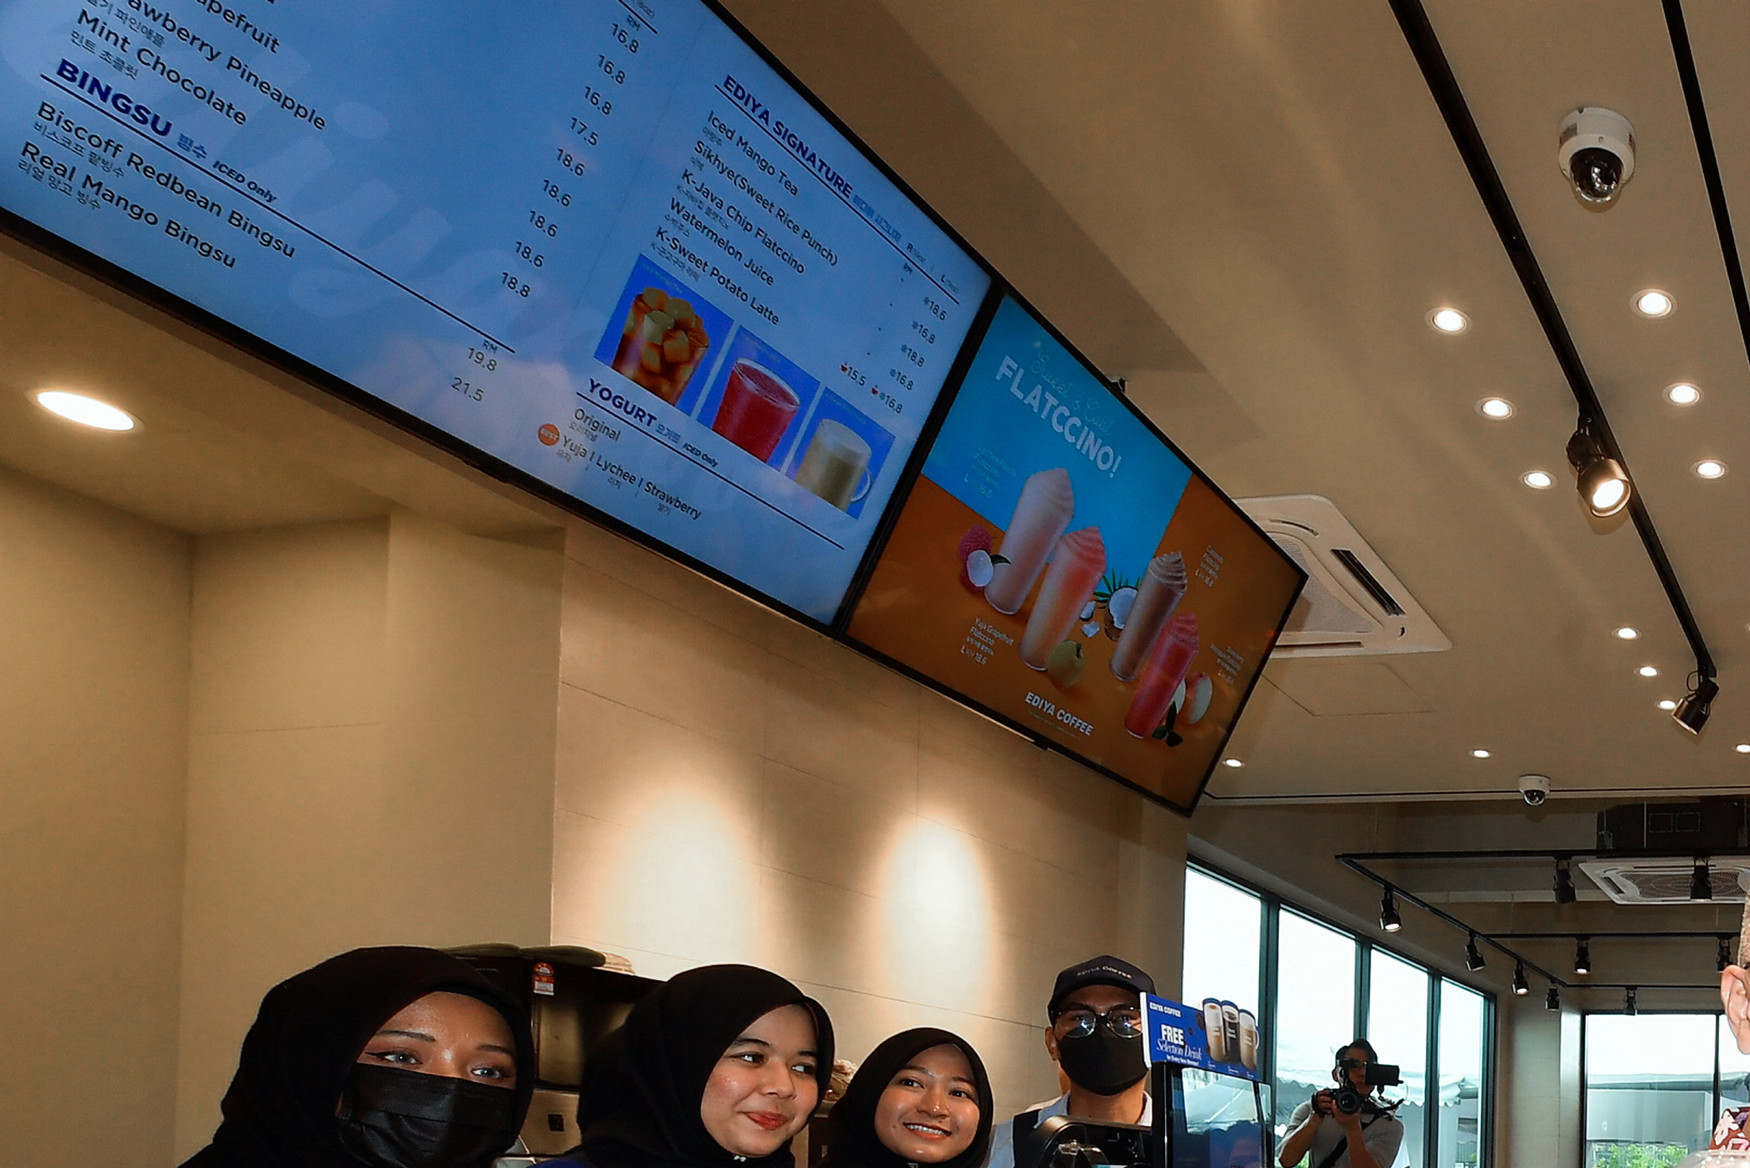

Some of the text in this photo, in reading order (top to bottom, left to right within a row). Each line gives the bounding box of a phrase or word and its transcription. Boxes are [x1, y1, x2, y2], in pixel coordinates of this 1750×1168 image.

[70, 30, 97, 54] 민트
[612, 23, 639, 54] 16.8
[77, 9, 625, 125] Mint Chocolate 16.8
[56, 58, 173, 137] BINGSU
[226, 56, 326, 130] Pineapple
[584, 86, 612, 115] 16.8
[34, 121, 85, 157] 비스코프
[571, 117, 599, 146] 17.5
[723, 75, 853, 198] EDIYA SIGNATURE
[557, 148, 585, 176] 18.6
[707, 111, 736, 140] Iced
[736, 136, 775, 176] Mango
[779, 171, 799, 196] Tea
[37, 101, 296, 258] Biscoff Redbean Bingsu
[212, 160, 277, 204] ICED Only
[543, 179, 571, 207] 18.6
[21, 141, 236, 268] Real Mango Bingsu
[694, 140, 775, 213] Sikhye(Sweet
[776, 208, 800, 234] Rice
[802, 229, 838, 266] Punch)
[529, 210, 558, 237] 18.6
[682, 169, 724, 210] K-Java
[726, 206, 753, 233] Chip
[754, 228, 805, 274] Flatccino
[515, 241, 545, 268] 18.6
[670, 198, 743, 262] Watermelon
[744, 258, 775, 286] Juice
[501, 272, 531, 298] 18.8
[656, 227, 708, 273] K-Sweet
[710, 267, 749, 302] Potato
[750, 297, 779, 325] Latte
[929, 300, 947, 321] 18.6
[483, 340, 498, 354] RM
[918, 324, 936, 344] 16.8
[467, 347, 497, 372] 19.8
[907, 348, 925, 367] 18.8
[451, 377, 484, 401] 21.5
[847, 366, 867, 386] 15.5
[886, 395, 904, 414] 16.8
[896, 372, 914, 391] 16.8
[589, 378, 657, 427] YOGURT
[995, 355, 1122, 478] FLATCCINO!
[574, 409, 621, 441] Original
[683, 442, 702, 458] ICED
[562, 435, 702, 520] Yuja Lychee Strawberry
[1025, 692, 1094, 736] EDIYA COFFEE
[1156, 1038, 1185, 1056] Selection
[1161, 1024, 1184, 1046] FREE
